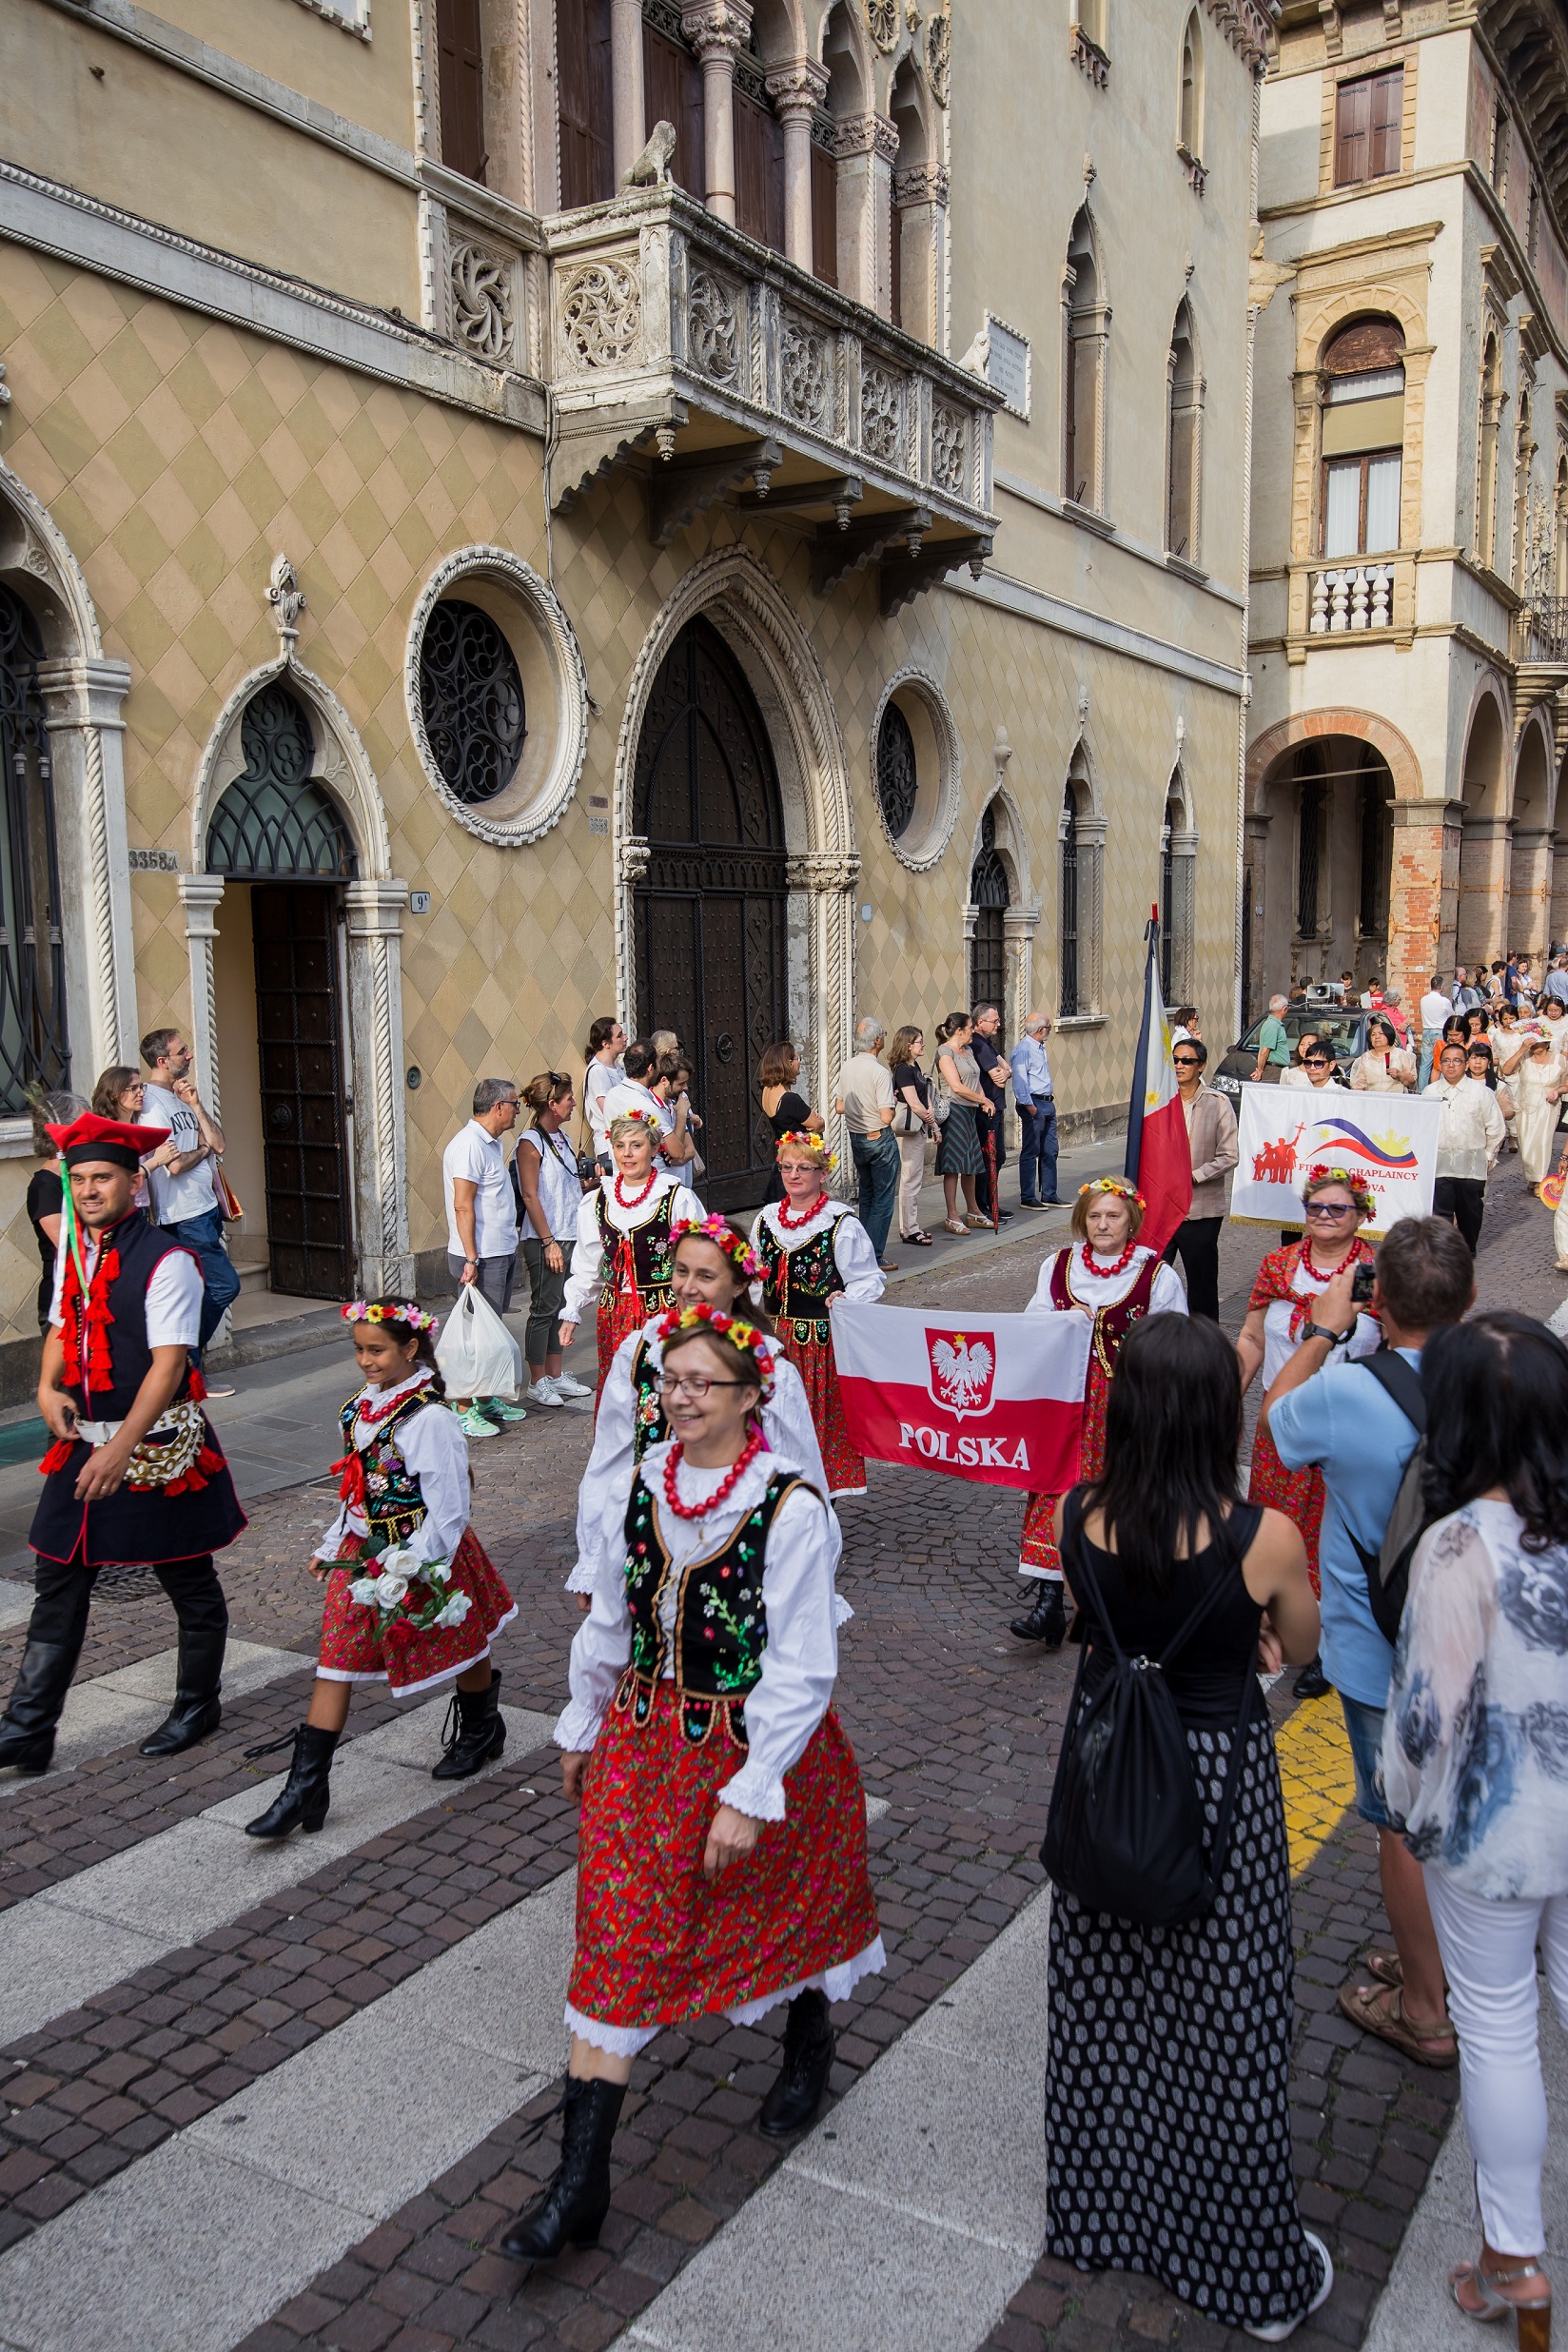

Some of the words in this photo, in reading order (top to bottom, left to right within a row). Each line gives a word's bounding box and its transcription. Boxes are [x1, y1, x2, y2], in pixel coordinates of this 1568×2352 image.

[170, 1110, 200, 1136] NIKE
[1349, 1167, 1419, 1181] CHAPLAINCY
[898, 1422, 1030, 1472] POLSKA
